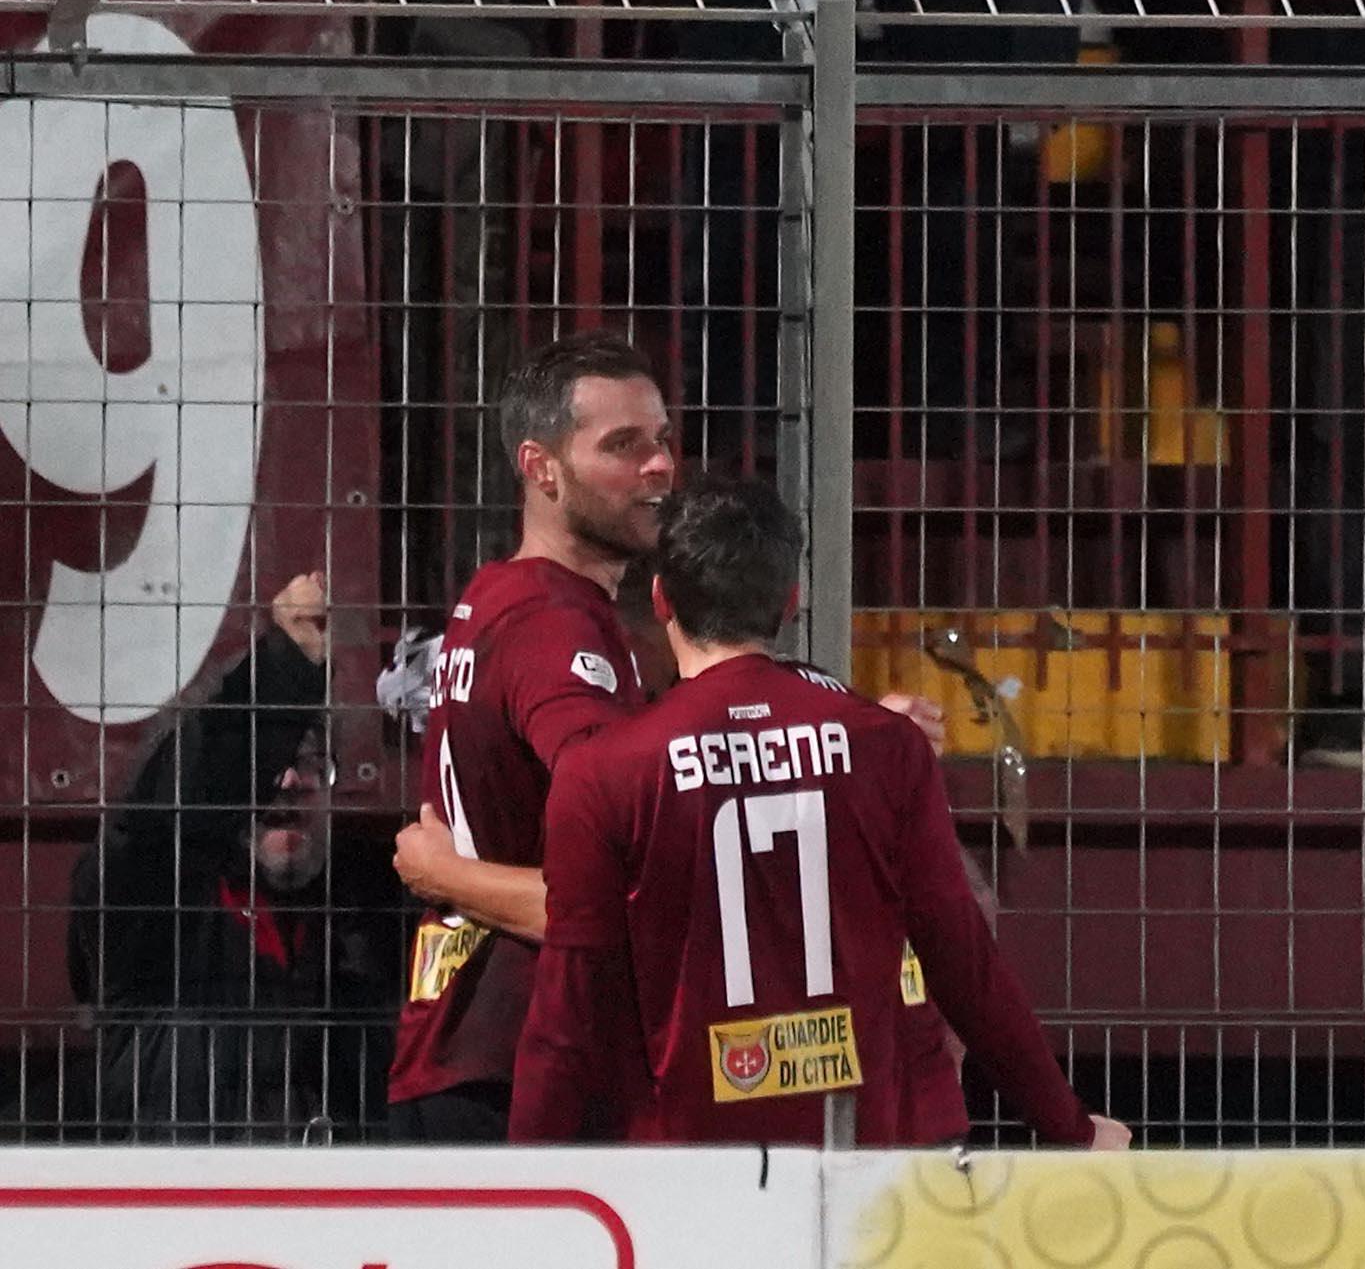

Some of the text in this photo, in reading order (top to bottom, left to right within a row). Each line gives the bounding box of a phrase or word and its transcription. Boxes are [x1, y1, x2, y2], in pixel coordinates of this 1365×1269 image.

[0, 13, 265, 725] 9
[668, 722, 851, 792] SERENA
[713, 789, 834, 1008] 17
[773, 1015, 848, 1051] GUARDIE
[779, 1060, 797, 1088] DI
